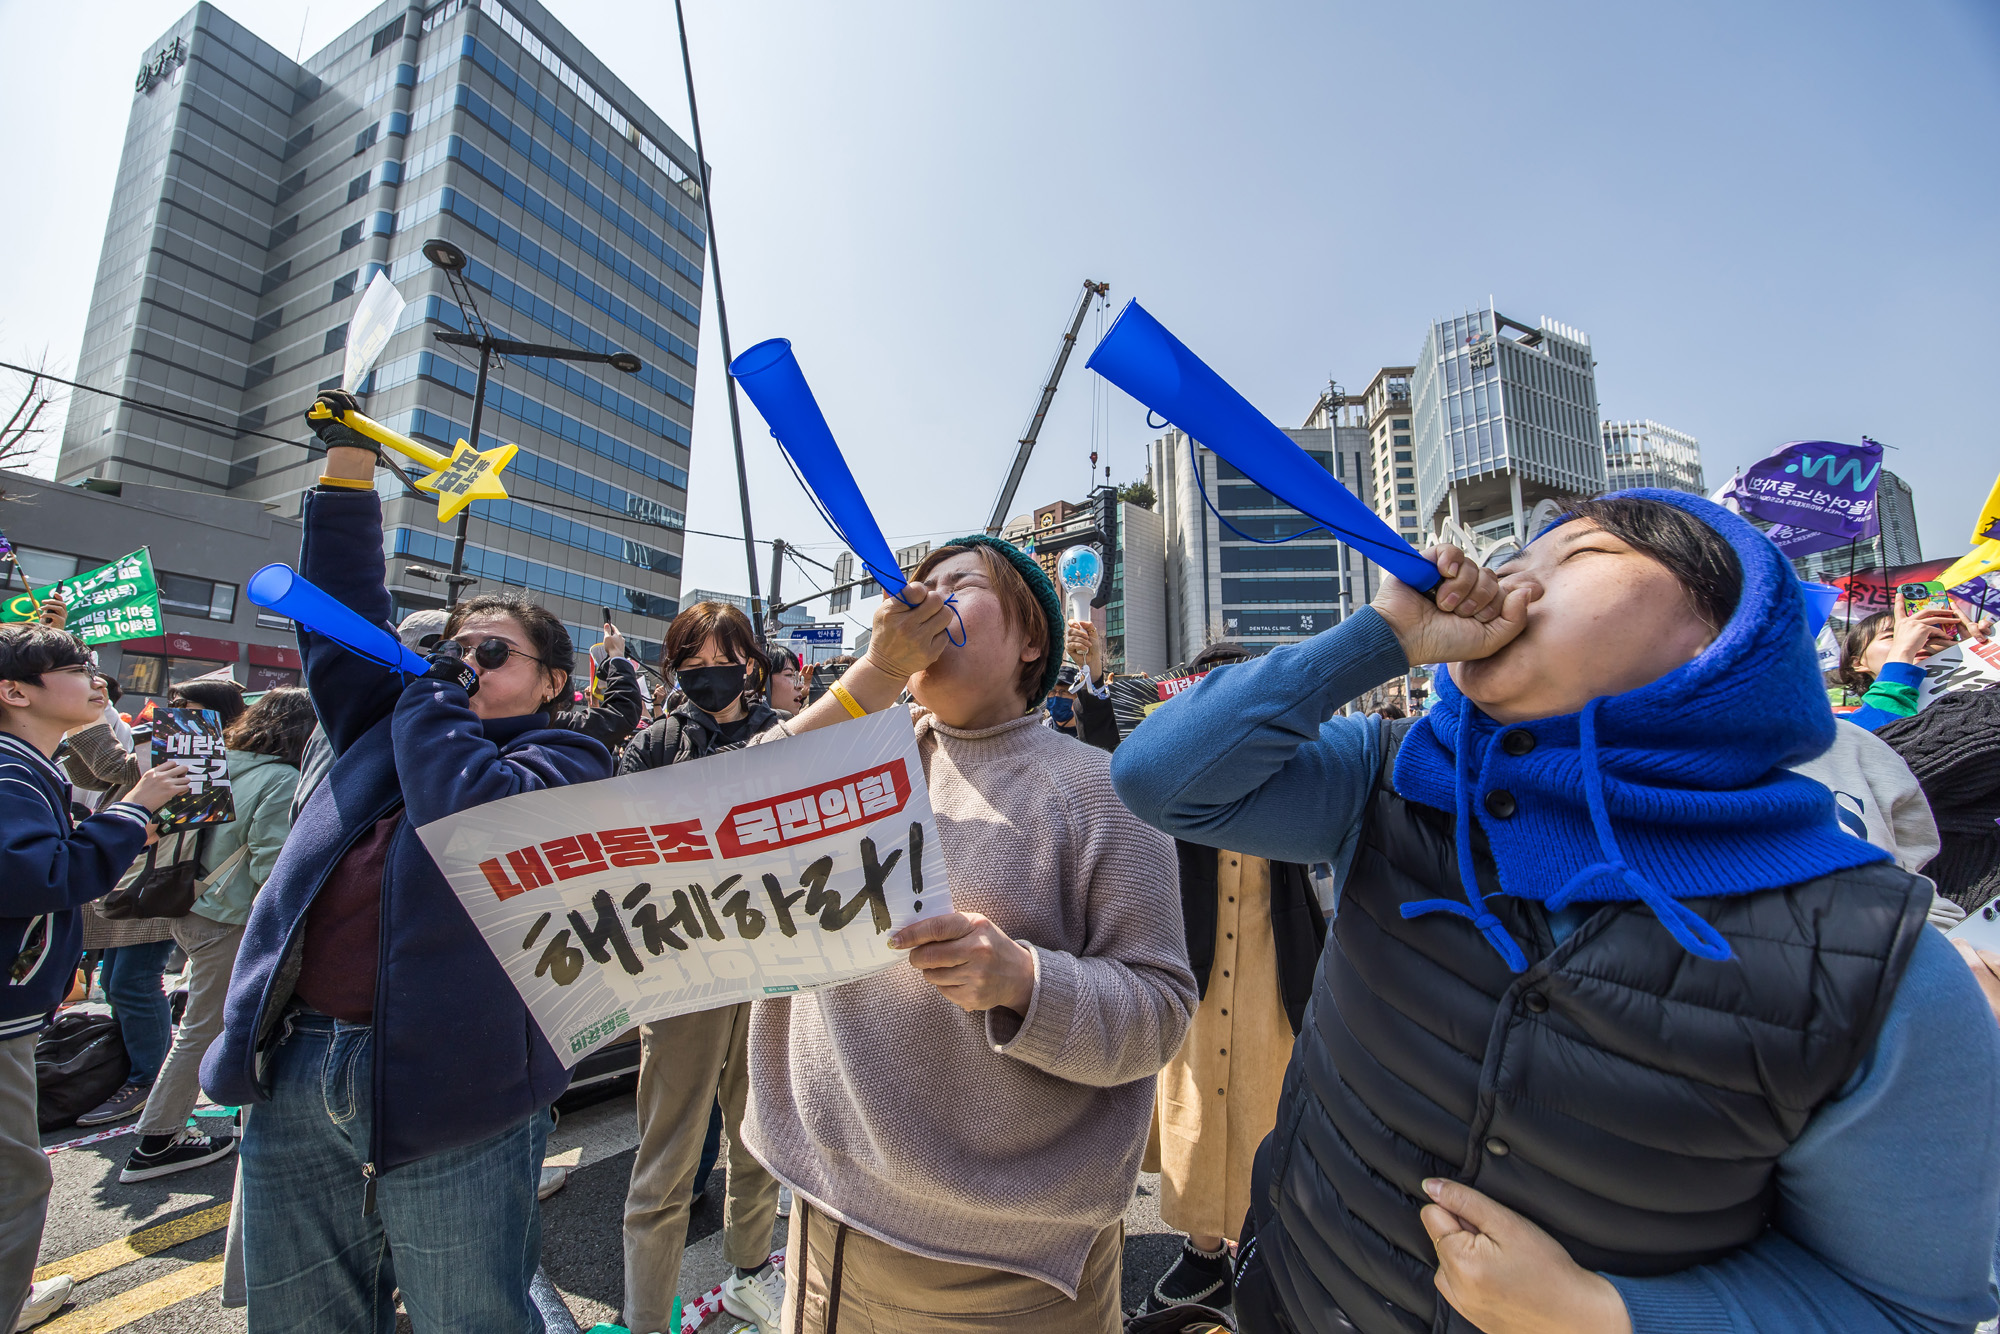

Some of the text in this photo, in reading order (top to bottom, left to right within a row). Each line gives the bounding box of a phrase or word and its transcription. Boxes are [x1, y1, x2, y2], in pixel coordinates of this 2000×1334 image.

[435, 449, 480, 492] 파면
[452, 459, 490, 495] 윤석열
[478, 770, 898, 902] 내란동조 국민의힘
[522, 821, 925, 987] 해체하라!
